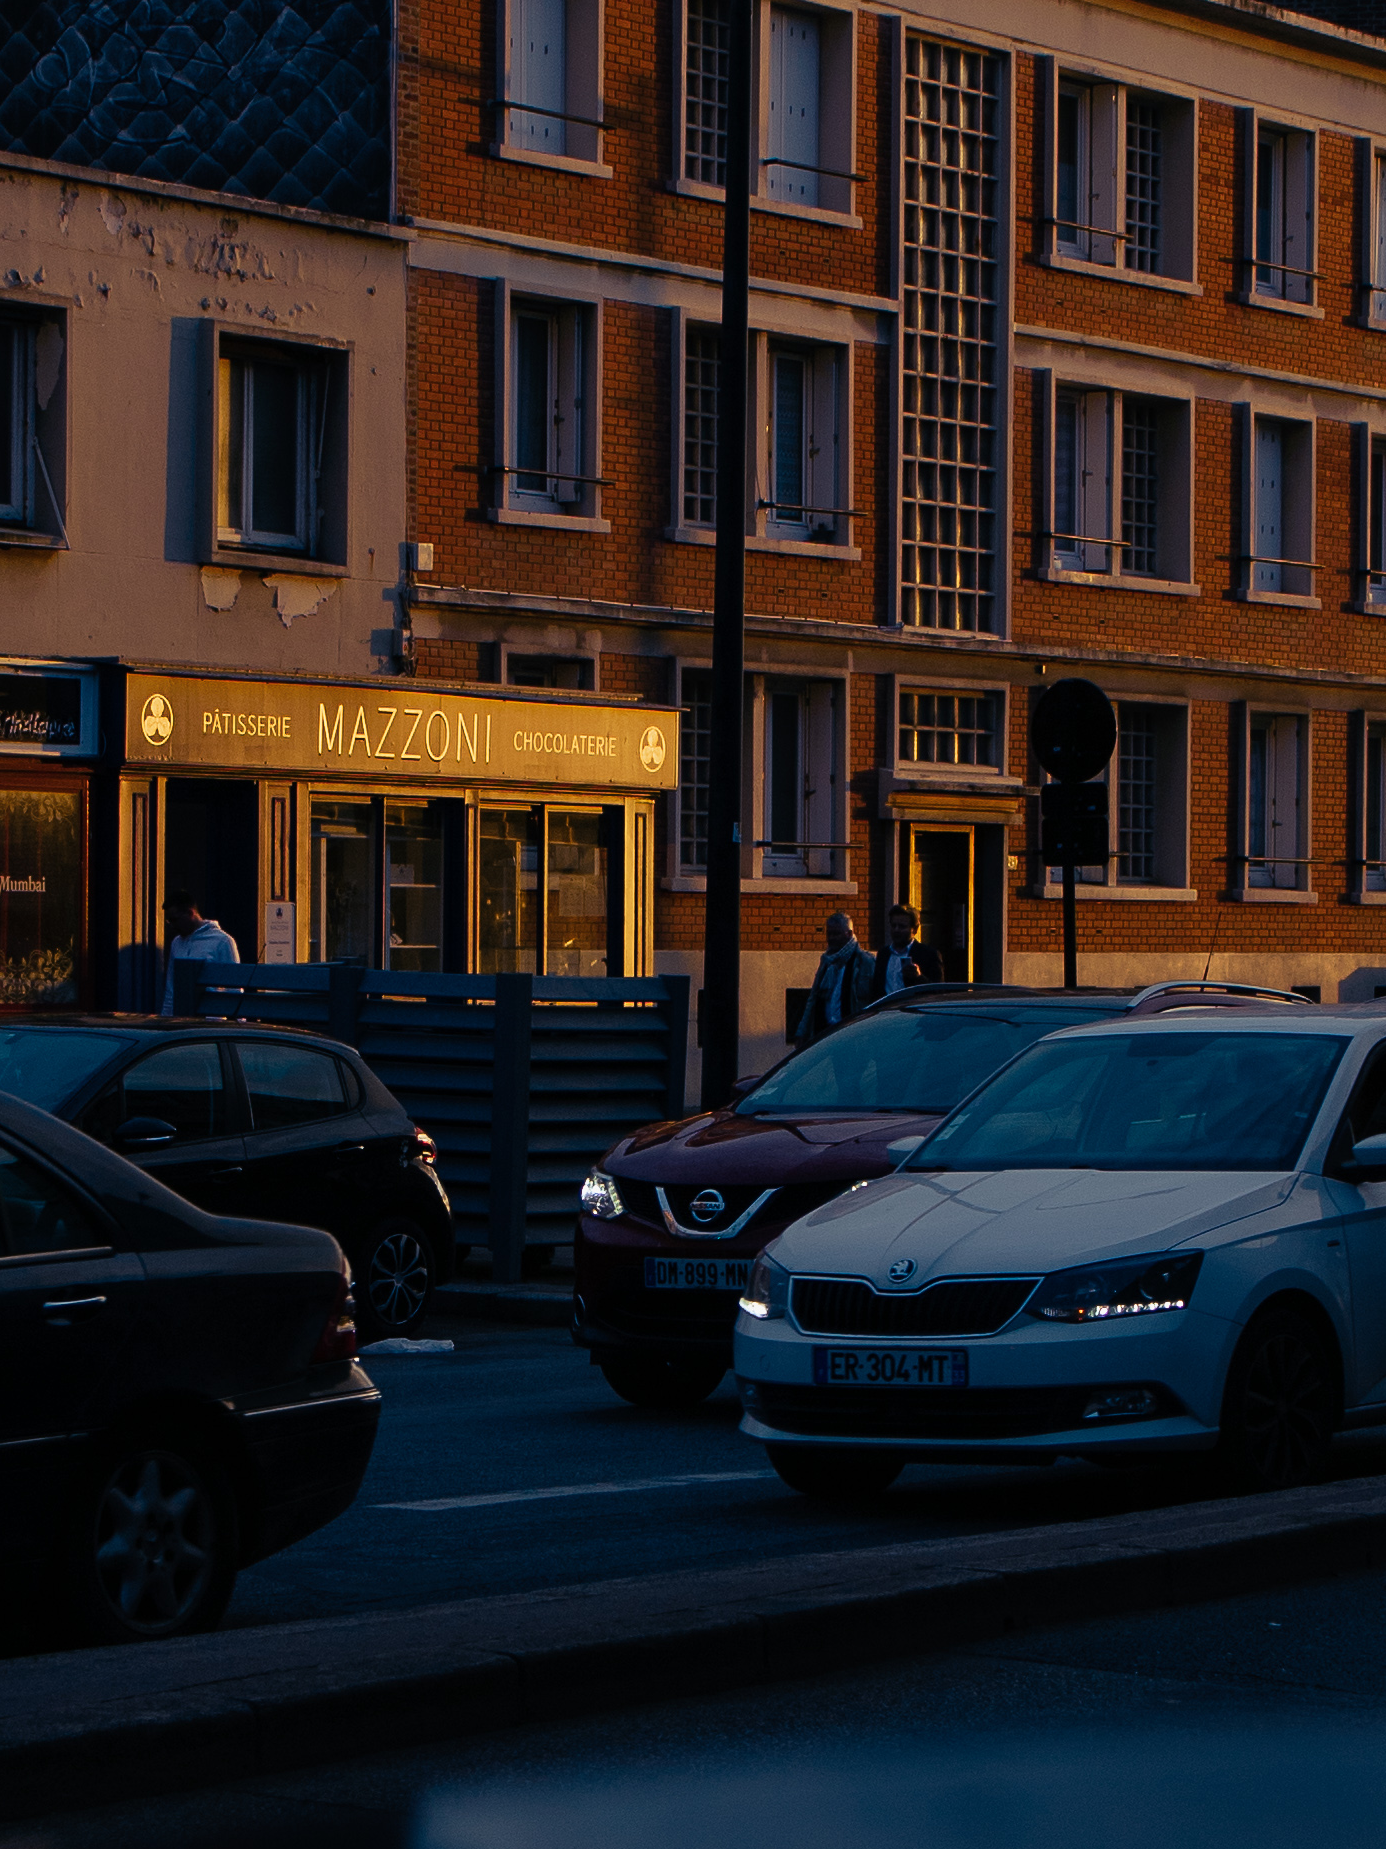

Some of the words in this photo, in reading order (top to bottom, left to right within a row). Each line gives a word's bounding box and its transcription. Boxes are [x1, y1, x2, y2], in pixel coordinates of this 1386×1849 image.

[202, 708, 292, 739] PÂTISSERIE
[317, 702, 492, 764] MAZZONI
[513, 729, 617, 758] CHOCOLATERIE
[656, 1258, 748, 1287] DM-899-MN
[830, 1352, 949, 1383] ER-304-MT
